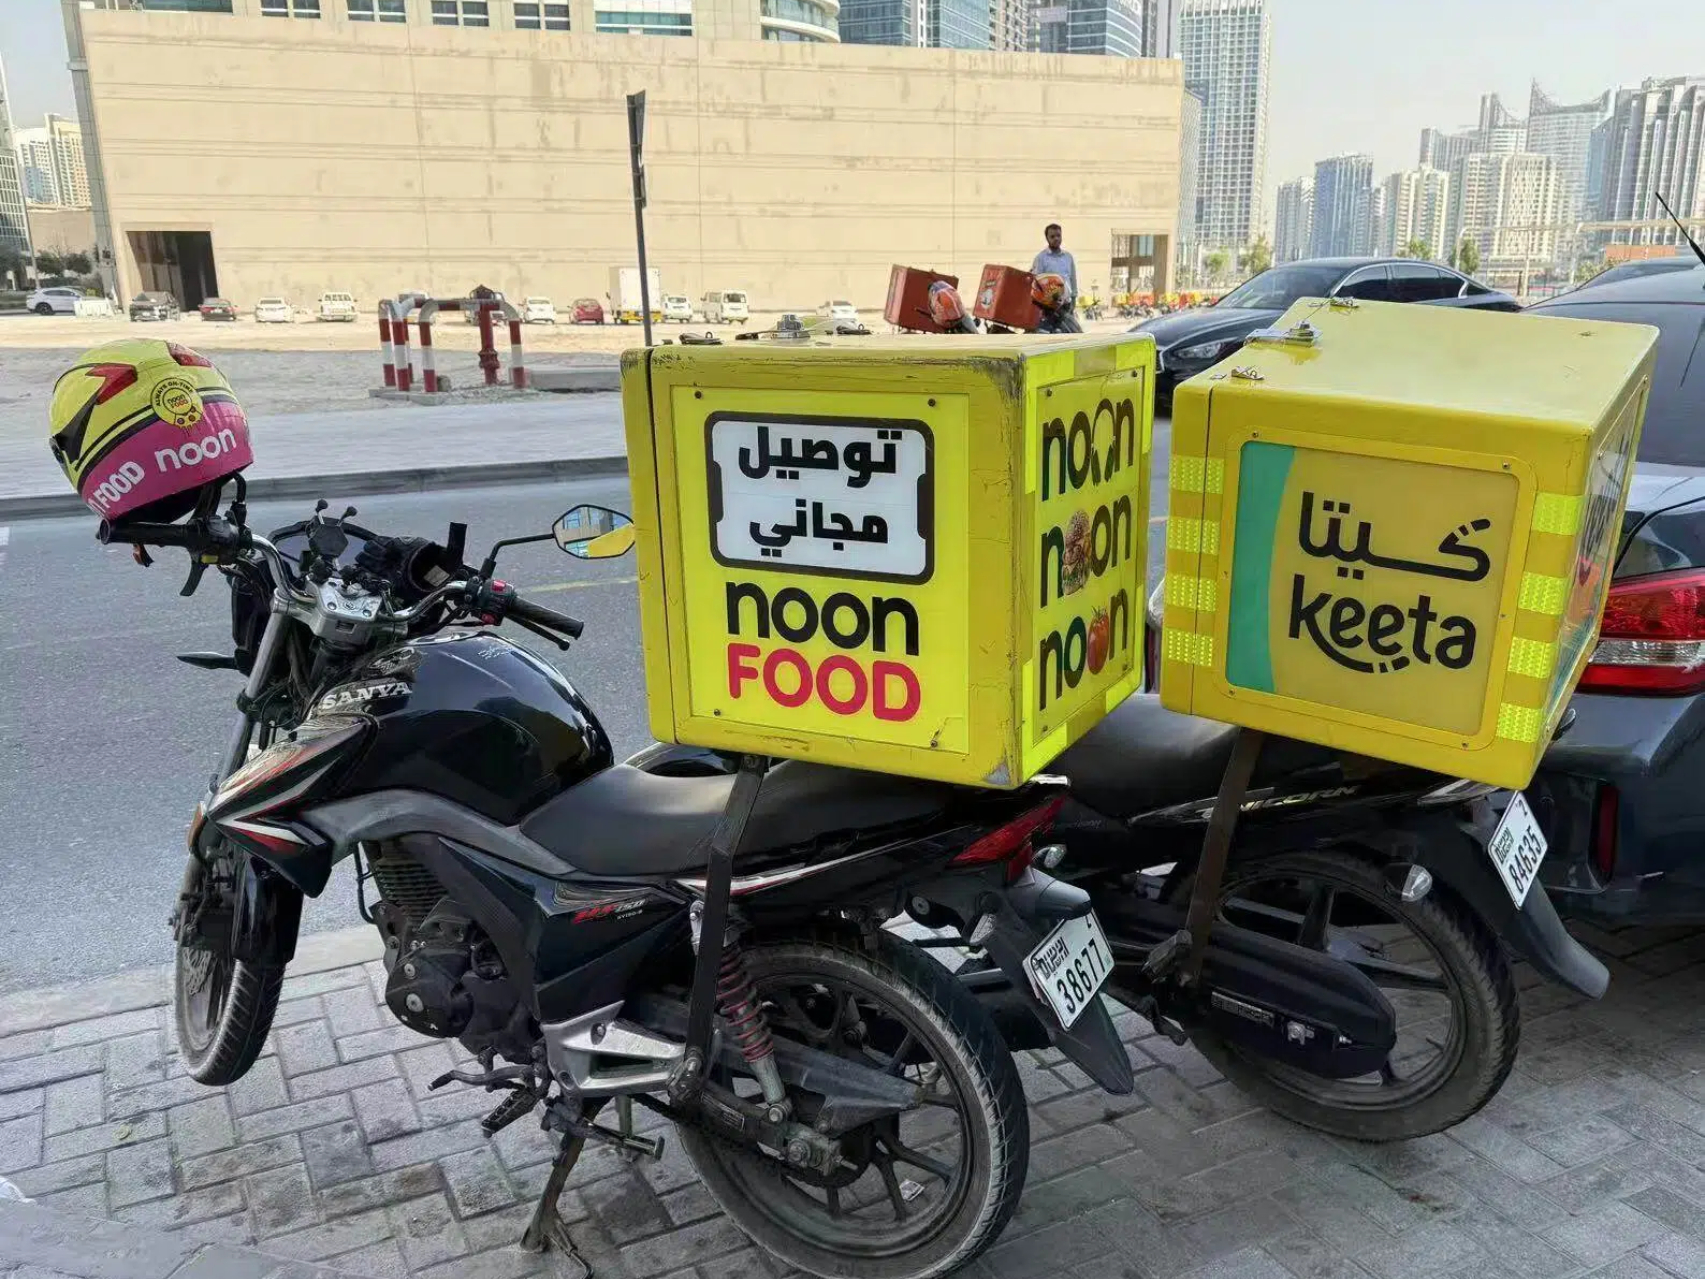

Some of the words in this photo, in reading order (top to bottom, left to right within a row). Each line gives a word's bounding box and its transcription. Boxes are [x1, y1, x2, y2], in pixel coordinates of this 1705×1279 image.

[154, 383, 168, 407] ALWAYS
[93, 461, 145, 509] FOOD
[154, 428, 236, 472] noon
[739, 426, 902, 488] توصيل
[750, 499, 888, 557] مجاني
[1040, 494, 1131, 609] non
[1299, 491, 1490, 581] كيتا
[726, 581, 919, 657] noon
[1039, 588, 1128, 712] non
[1288, 574, 1477, 674] keeta
[321, 682, 413, 709] SANYA
[727, 643, 921, 722] FOOD
[1240, 785, 1361, 812] NICORN
[1508, 824, 1542, 894] 84635
[1056, 937, 1106, 1014] 38677
